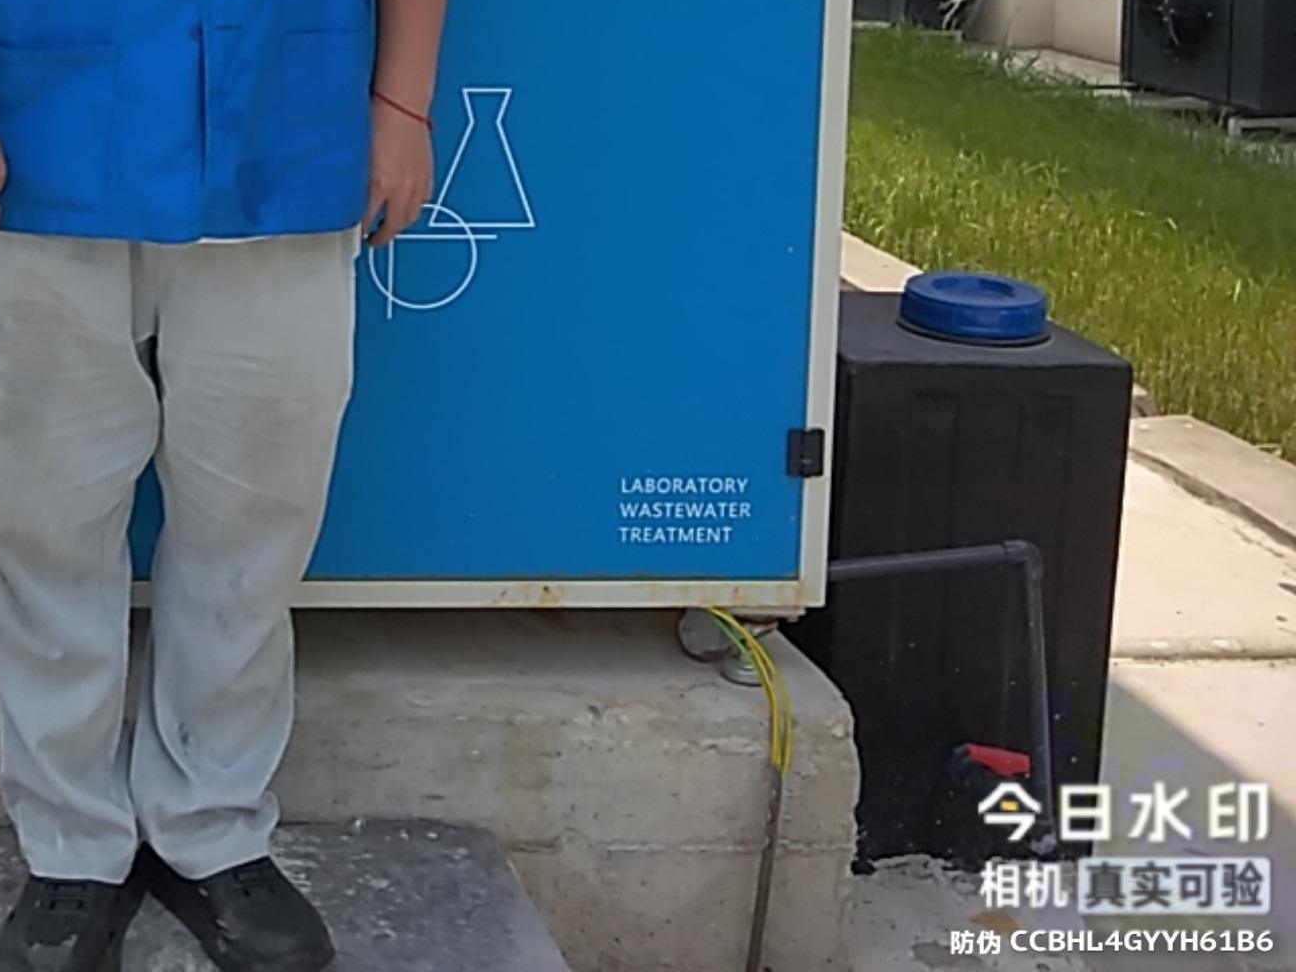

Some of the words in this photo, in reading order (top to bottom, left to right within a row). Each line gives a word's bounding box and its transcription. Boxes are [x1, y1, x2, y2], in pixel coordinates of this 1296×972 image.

[621, 477, 749, 494] LABORATORY
[619, 502, 752, 518] WASTEWATER
[619, 526, 734, 543] TREATMENT
